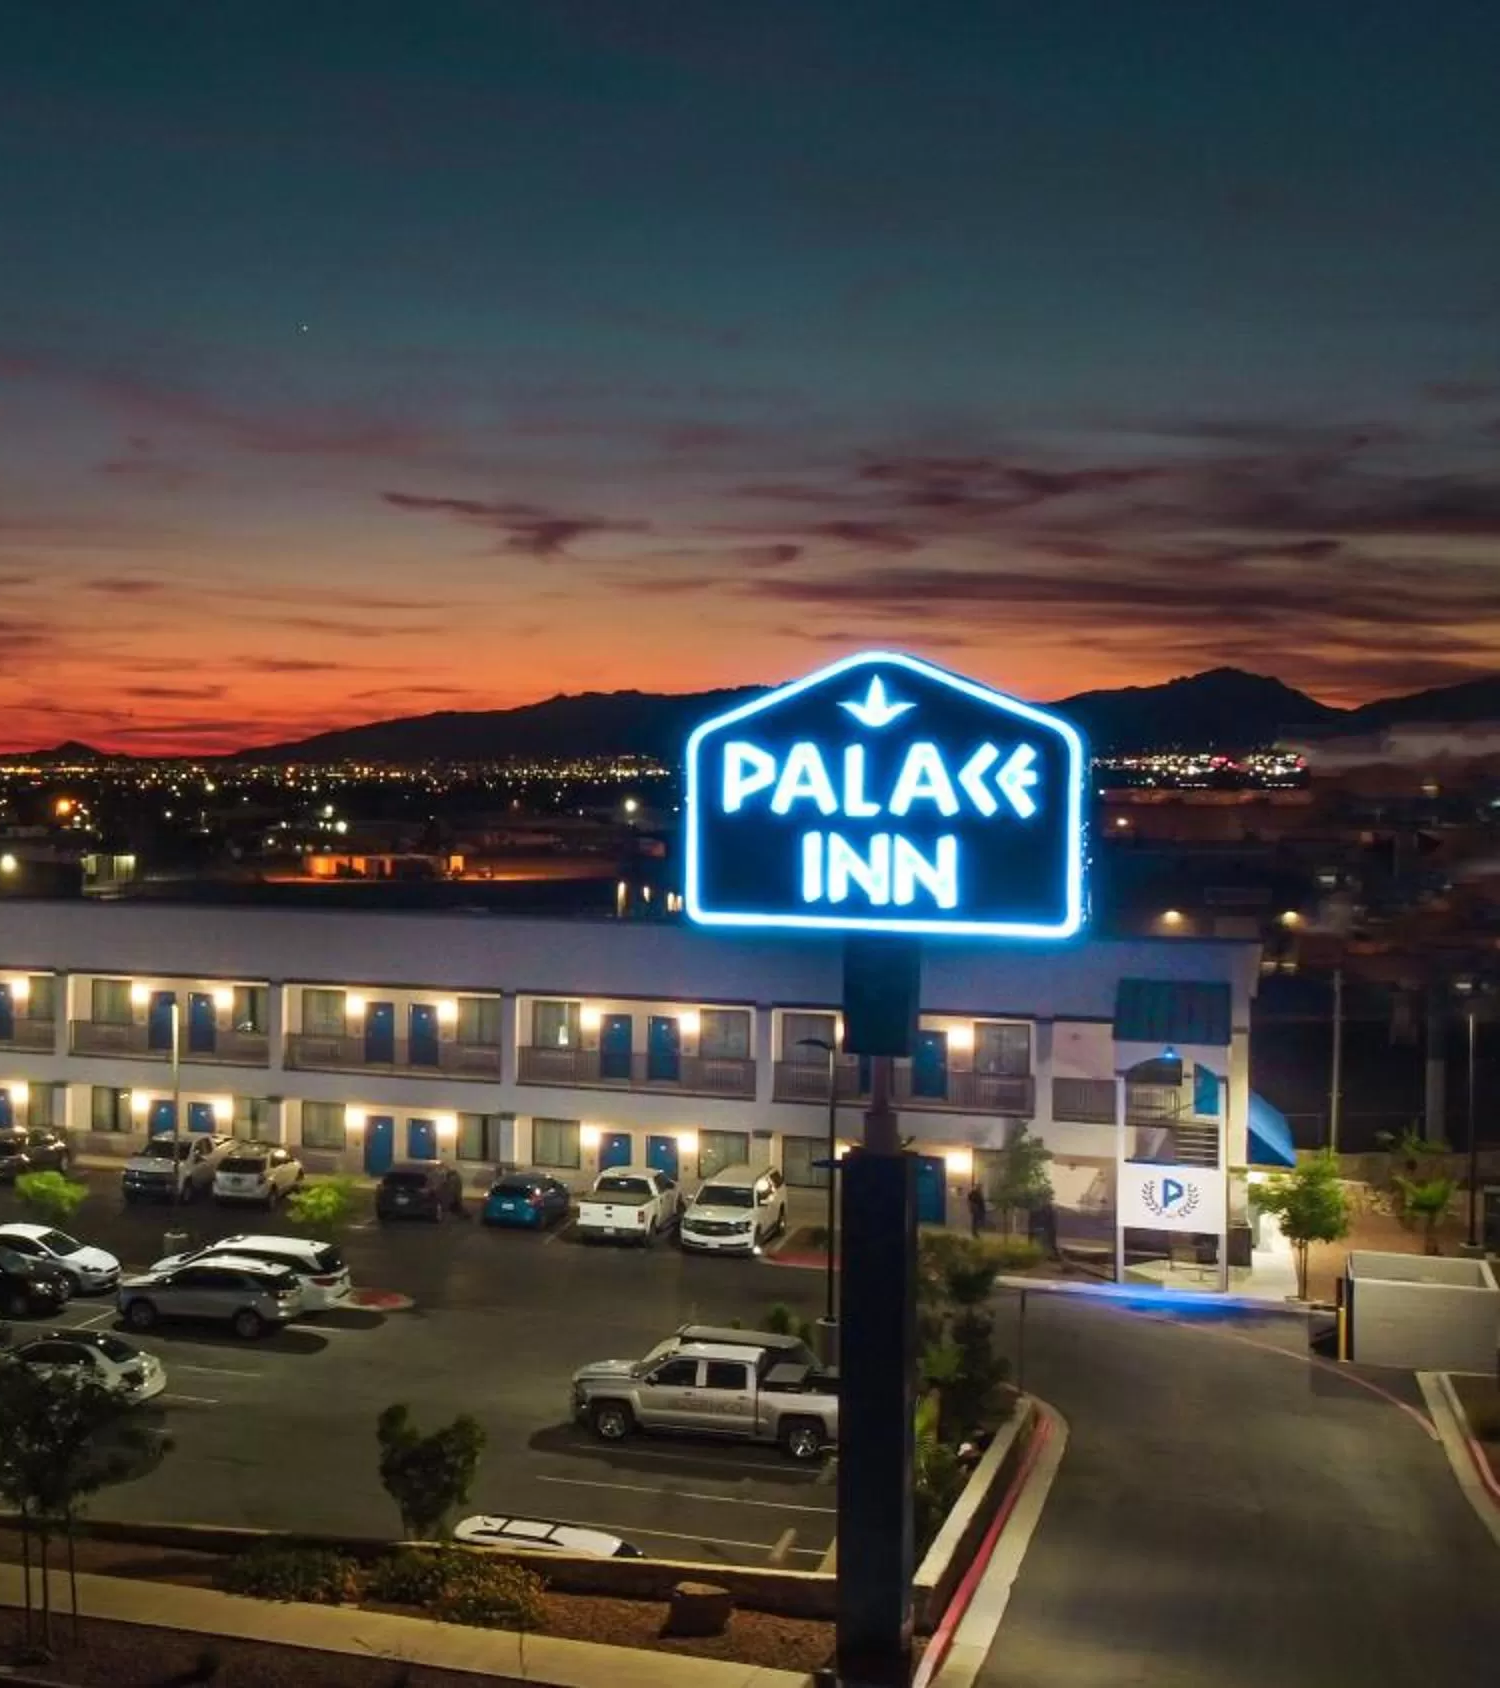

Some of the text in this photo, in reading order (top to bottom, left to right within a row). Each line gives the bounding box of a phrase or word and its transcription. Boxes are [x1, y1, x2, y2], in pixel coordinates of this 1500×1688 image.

[722, 741, 1038, 819] PALACE
[802, 830, 958, 909] INN
[1163, 1178, 1184, 1208] P
